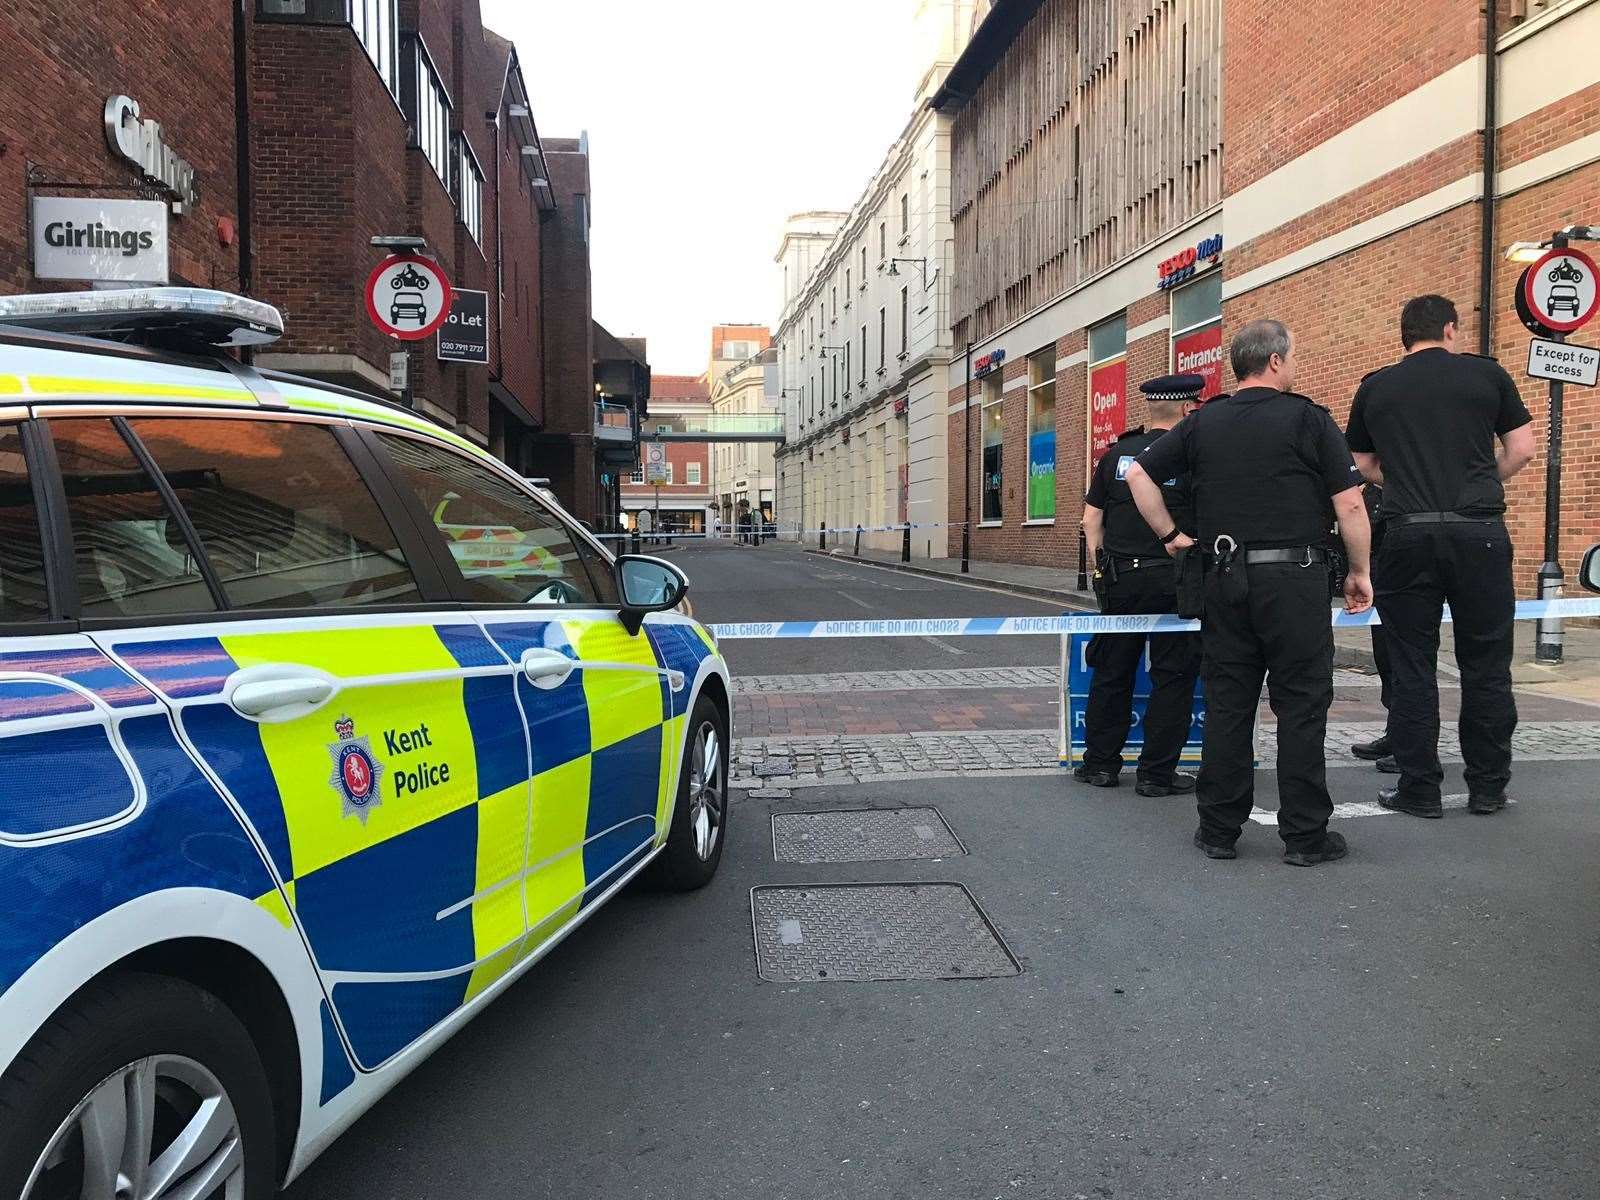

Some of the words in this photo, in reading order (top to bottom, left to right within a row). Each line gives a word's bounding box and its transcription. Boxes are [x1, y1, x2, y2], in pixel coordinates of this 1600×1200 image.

[44, 221, 153, 256] Girlings
[1157, 247, 1196, 278] TESCO
[461, 312, 482, 327] Let
[441, 342, 454, 350] 020
[1536, 345, 1575, 362] Except
[1579, 352, 1594, 365] for
[1178, 346, 1222, 373] Entrance
[1544, 363, 1582, 377] access
[1093, 391, 1117, 415] Open
[1031, 457, 1055, 479] Organic
[383, 722, 433, 757] Kent
[393, 762, 450, 798] Police
